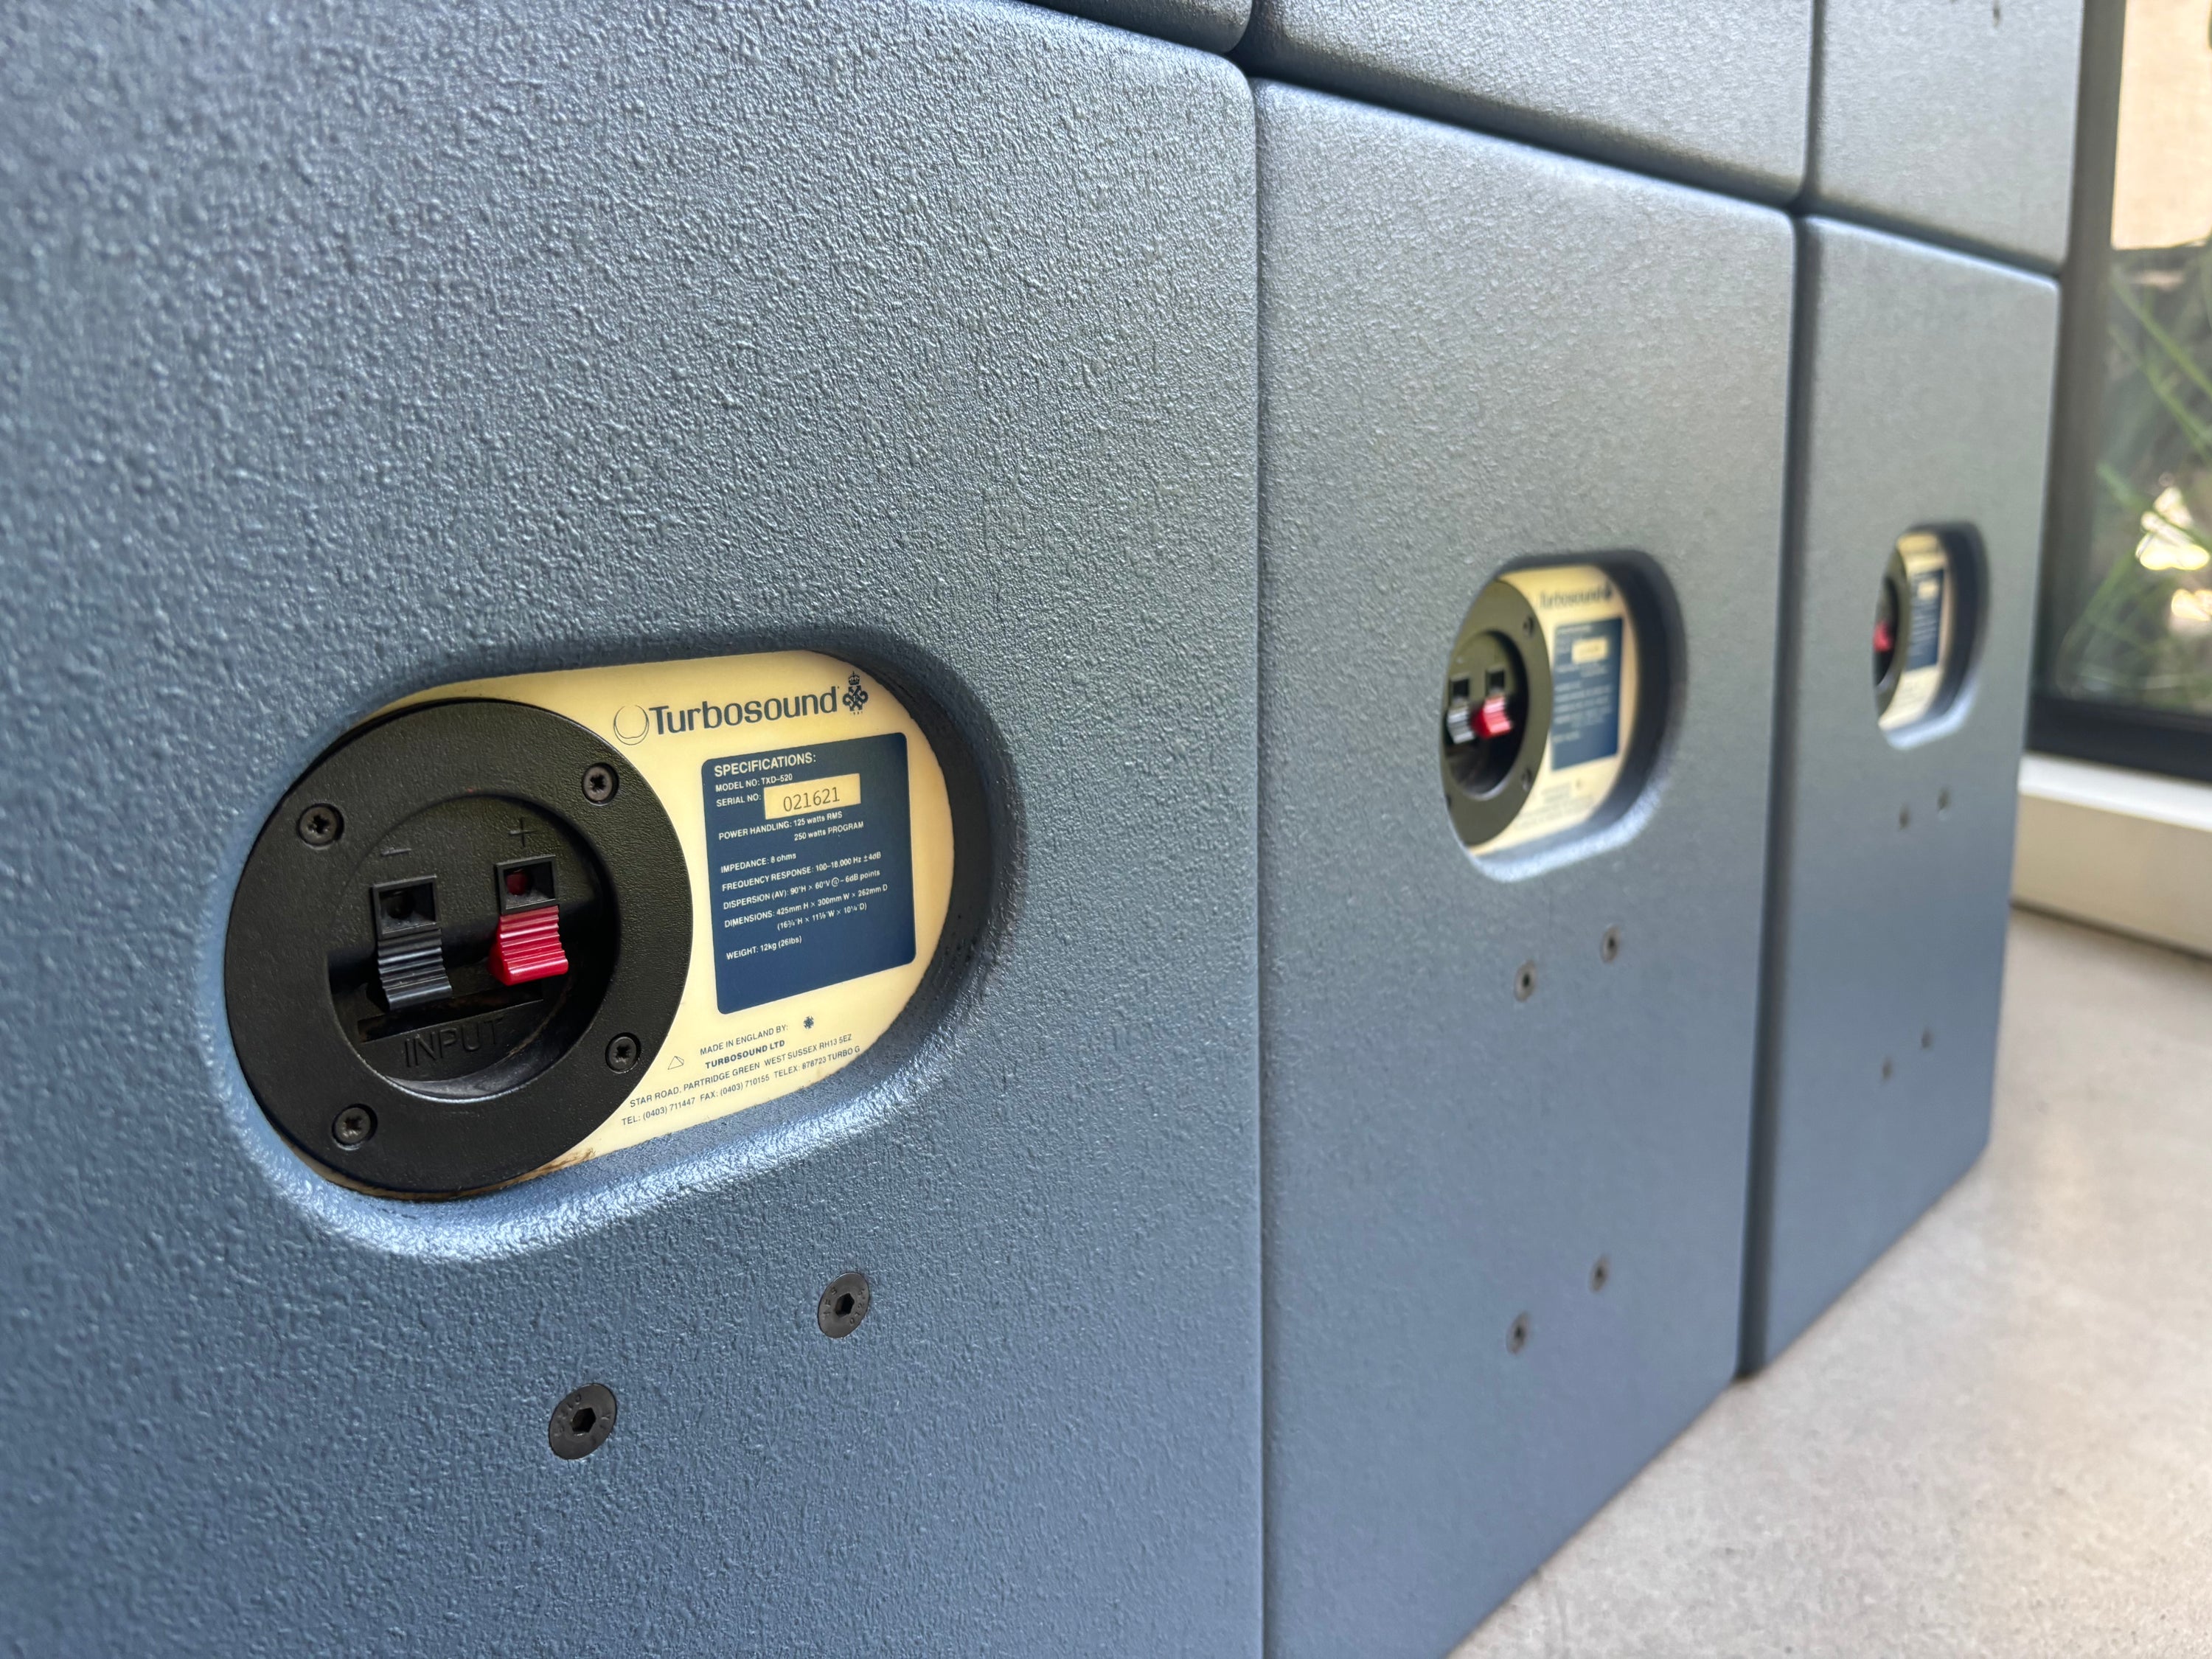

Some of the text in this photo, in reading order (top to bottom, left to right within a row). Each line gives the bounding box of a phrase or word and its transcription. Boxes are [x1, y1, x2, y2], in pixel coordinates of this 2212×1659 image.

[649, 686, 838, 735] Turbosound
[714, 752, 816, 777] SPECIFICATIONS:
[715, 781, 744, 793] MODEL
[745, 779, 760, 787] NO:
[716, 787, 841, 812] SERIAL NO: 021621
[718, 810, 843, 841] POWER HANDLING: 125 watts RMS
[794, 821, 864, 841] 250 watts PROGRAM
[720, 853, 796, 874] IMPEDANCE: 8 ohms
[722, 875, 769, 891] FREQUENCY
[771, 866, 814, 881] RESPONSE:
[853, 856, 862, 864] Hz
[723, 893, 771, 910] DISPERSION
[772, 889, 789, 900] (AV):
[860, 869, 880, 882] points
[724, 910, 775, 928] DIMENSIONS:
[776, 903, 802, 916] 425mm
[803, 902, 809, 910] H
[818, 895, 842, 906] 300mm
[858, 886, 881, 897] 262mm
[883, 883, 888, 891] D
[726, 935, 802, 960] WEIGHT: 12kg (26lbs)
[404, 1017, 505, 1068] INPUT
[700, 1024, 788, 1055] MADE IN ENGLAND BY:
[705, 1040, 785, 1069] TURBOSOUND LTD
[621, 1045, 860, 1126] TEL: (0403) 711447 FAX: (0403) 710155 TELEX: 878723 TURBO G
[630, 1094, 653, 1107] STAR
[684, 1071, 730, 1091] PARTRIDGE
[732, 1062, 760, 1077] GREEN
[764, 1053, 786, 1067] WEST
[787, 1044, 818, 1060] SUSSEX
[819, 1039, 838, 1050] RH13
[839, 1033, 852, 1044] 5EZ
